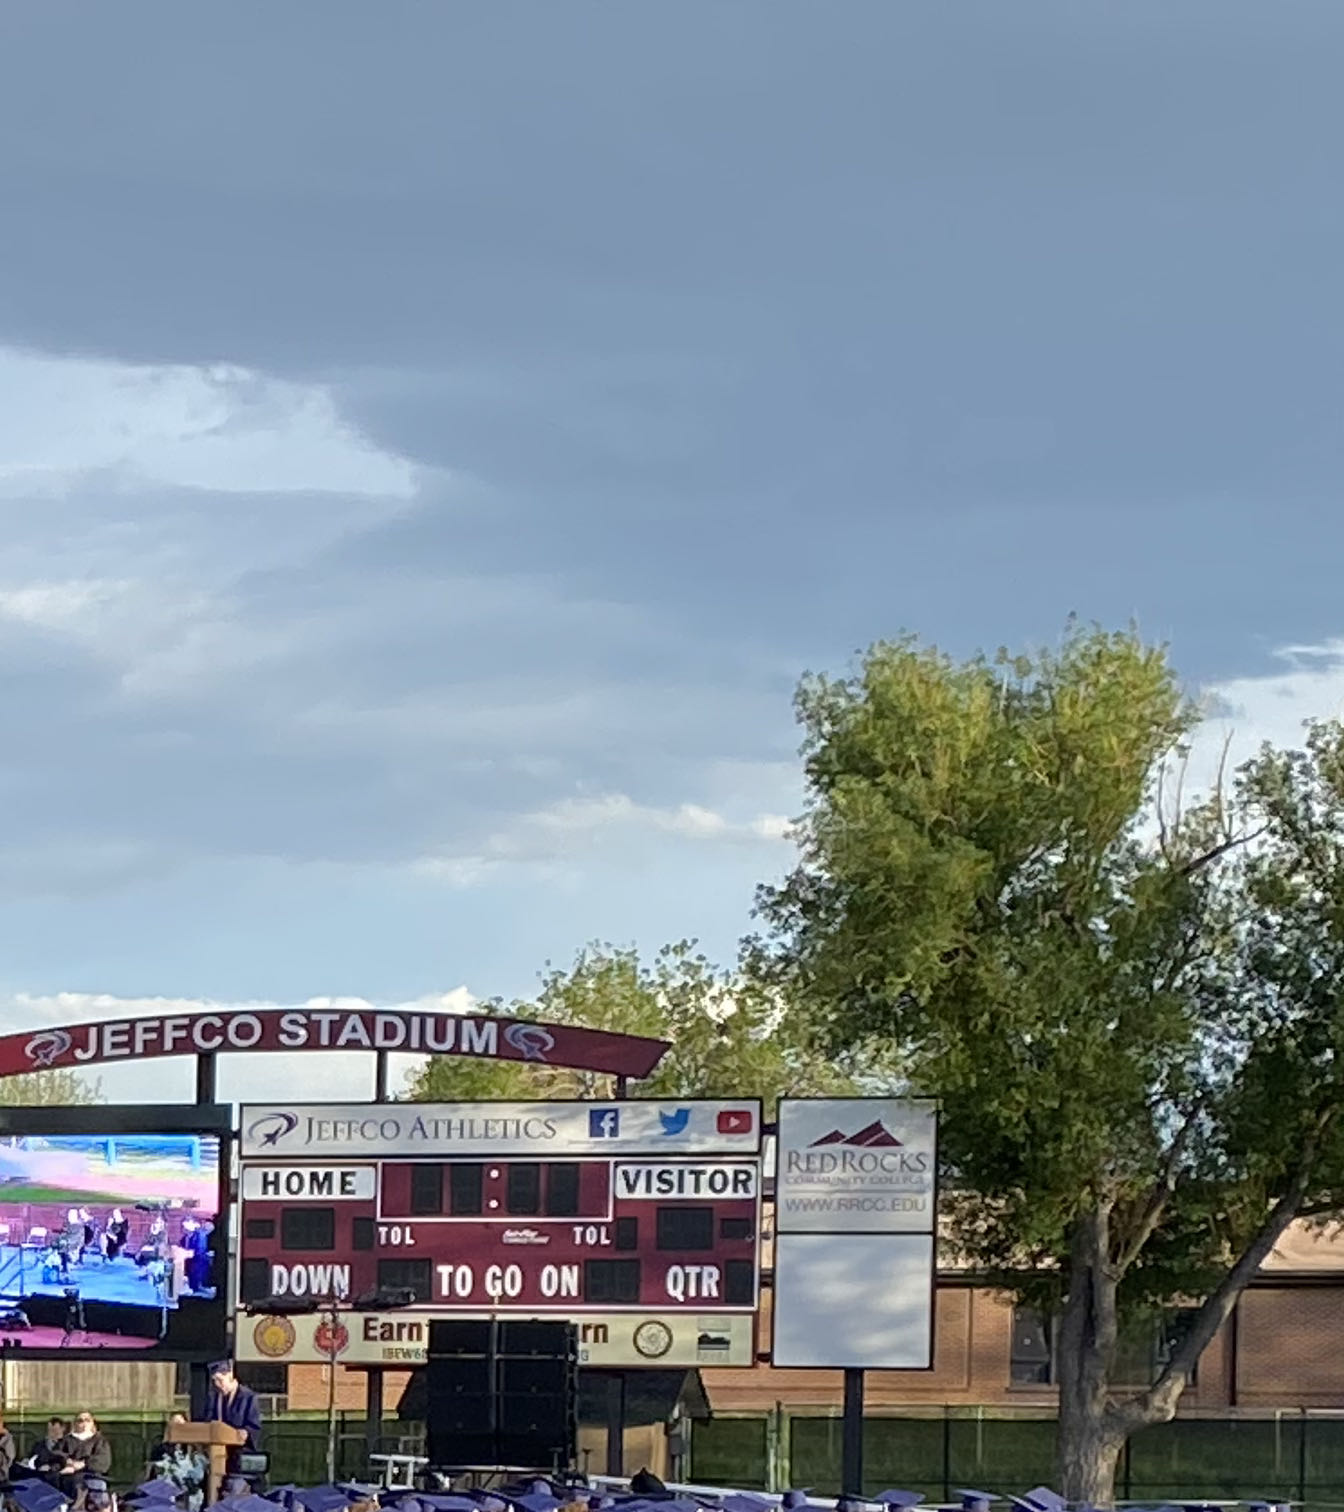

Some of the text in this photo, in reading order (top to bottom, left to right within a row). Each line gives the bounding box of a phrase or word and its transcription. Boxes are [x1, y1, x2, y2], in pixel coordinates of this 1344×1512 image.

[74, 1013, 498, 1061] JEFFCO STADIUM
[304, 1115, 558, 1146] JEFFCO ATHLETICS
[261, 1170, 357, 1196] HOME
[621, 1168, 753, 1195] VISITOR
[785, 1197, 927, 1213] WWW.RRCC.EDU
[378, 1226, 416, 1246] TOL
[573, 1225, 611, 1246] TOL
[271, 1264, 351, 1298] DOWN
[436, 1264, 580, 1298] TO GO ON
[666, 1264, 721, 1302] QTR
[363, 1316, 423, 1342] Earn
